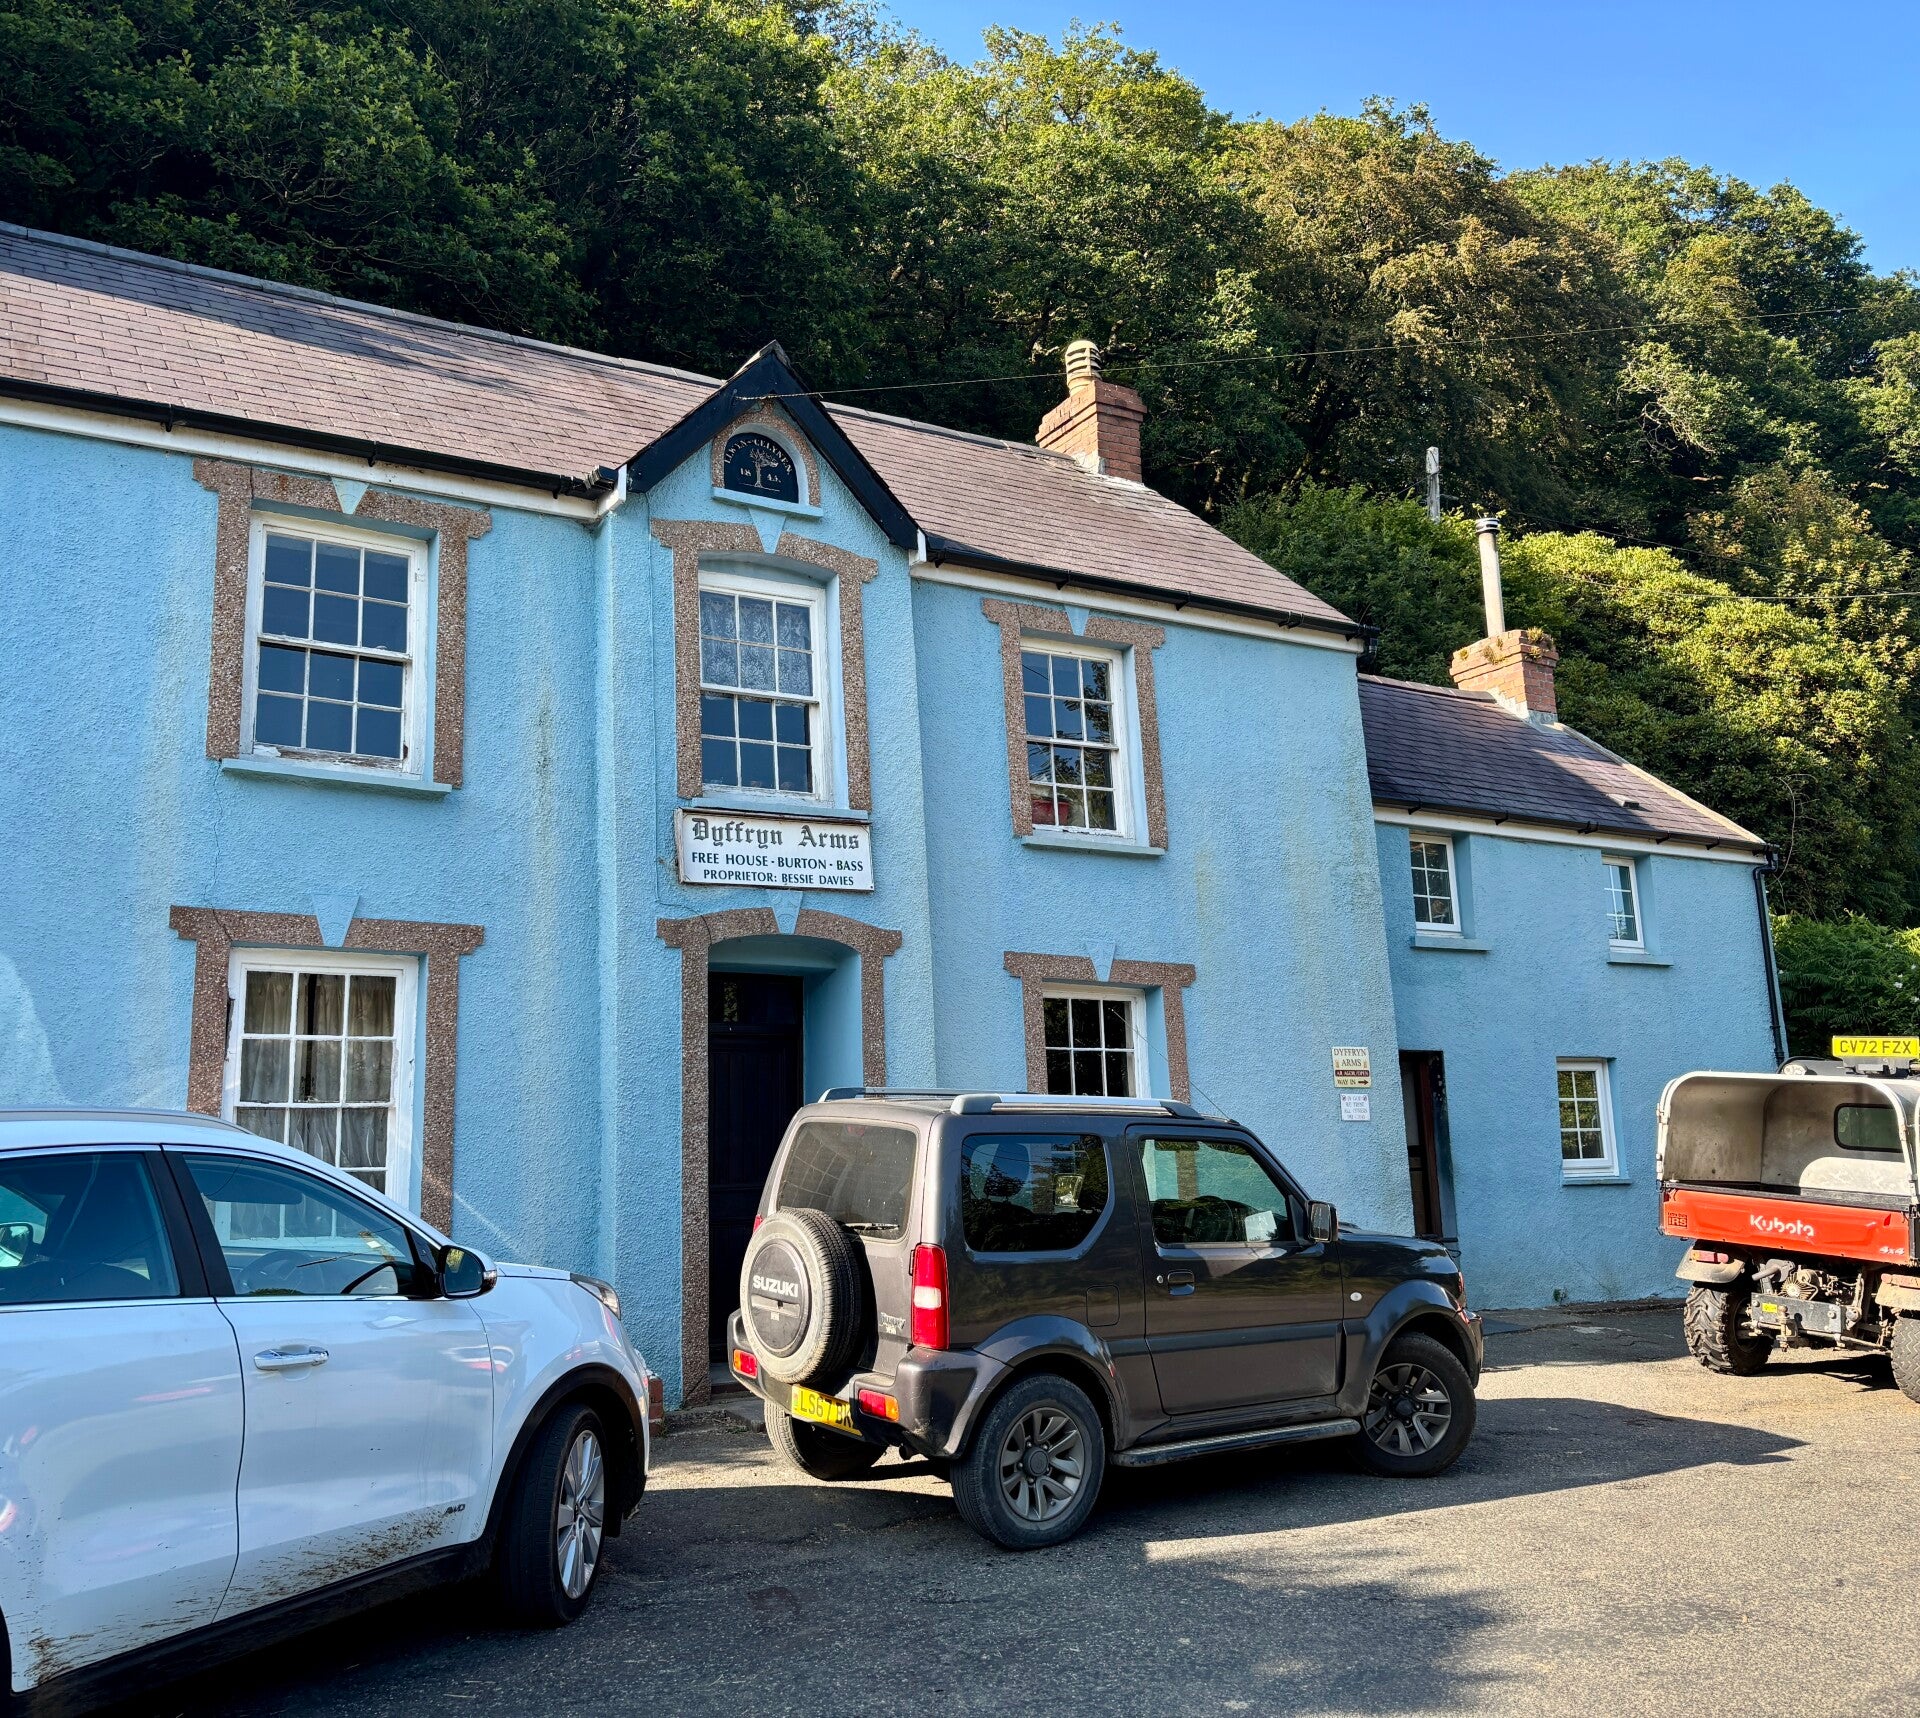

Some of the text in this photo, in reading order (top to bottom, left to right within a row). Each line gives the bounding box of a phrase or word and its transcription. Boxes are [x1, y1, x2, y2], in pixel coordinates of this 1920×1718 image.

[691, 817, 859, 849] Dyffryn Arms
[691, 852, 864, 872] FREE HOUSE BURTON BASS
[703, 869, 854, 886] PROPRIETOR: BESSIE DAVIES
[1333, 1048, 1367, 1056] DYFFRYN
[1840, 1040, 1912, 1054] CV72 FZX
[1341, 1059, 1362, 1067] ARMS
[1668, 1217, 1687, 1227] IRS
[1750, 1214, 1815, 1237] Kubota
[752, 1275, 799, 1298] SUZUKI
